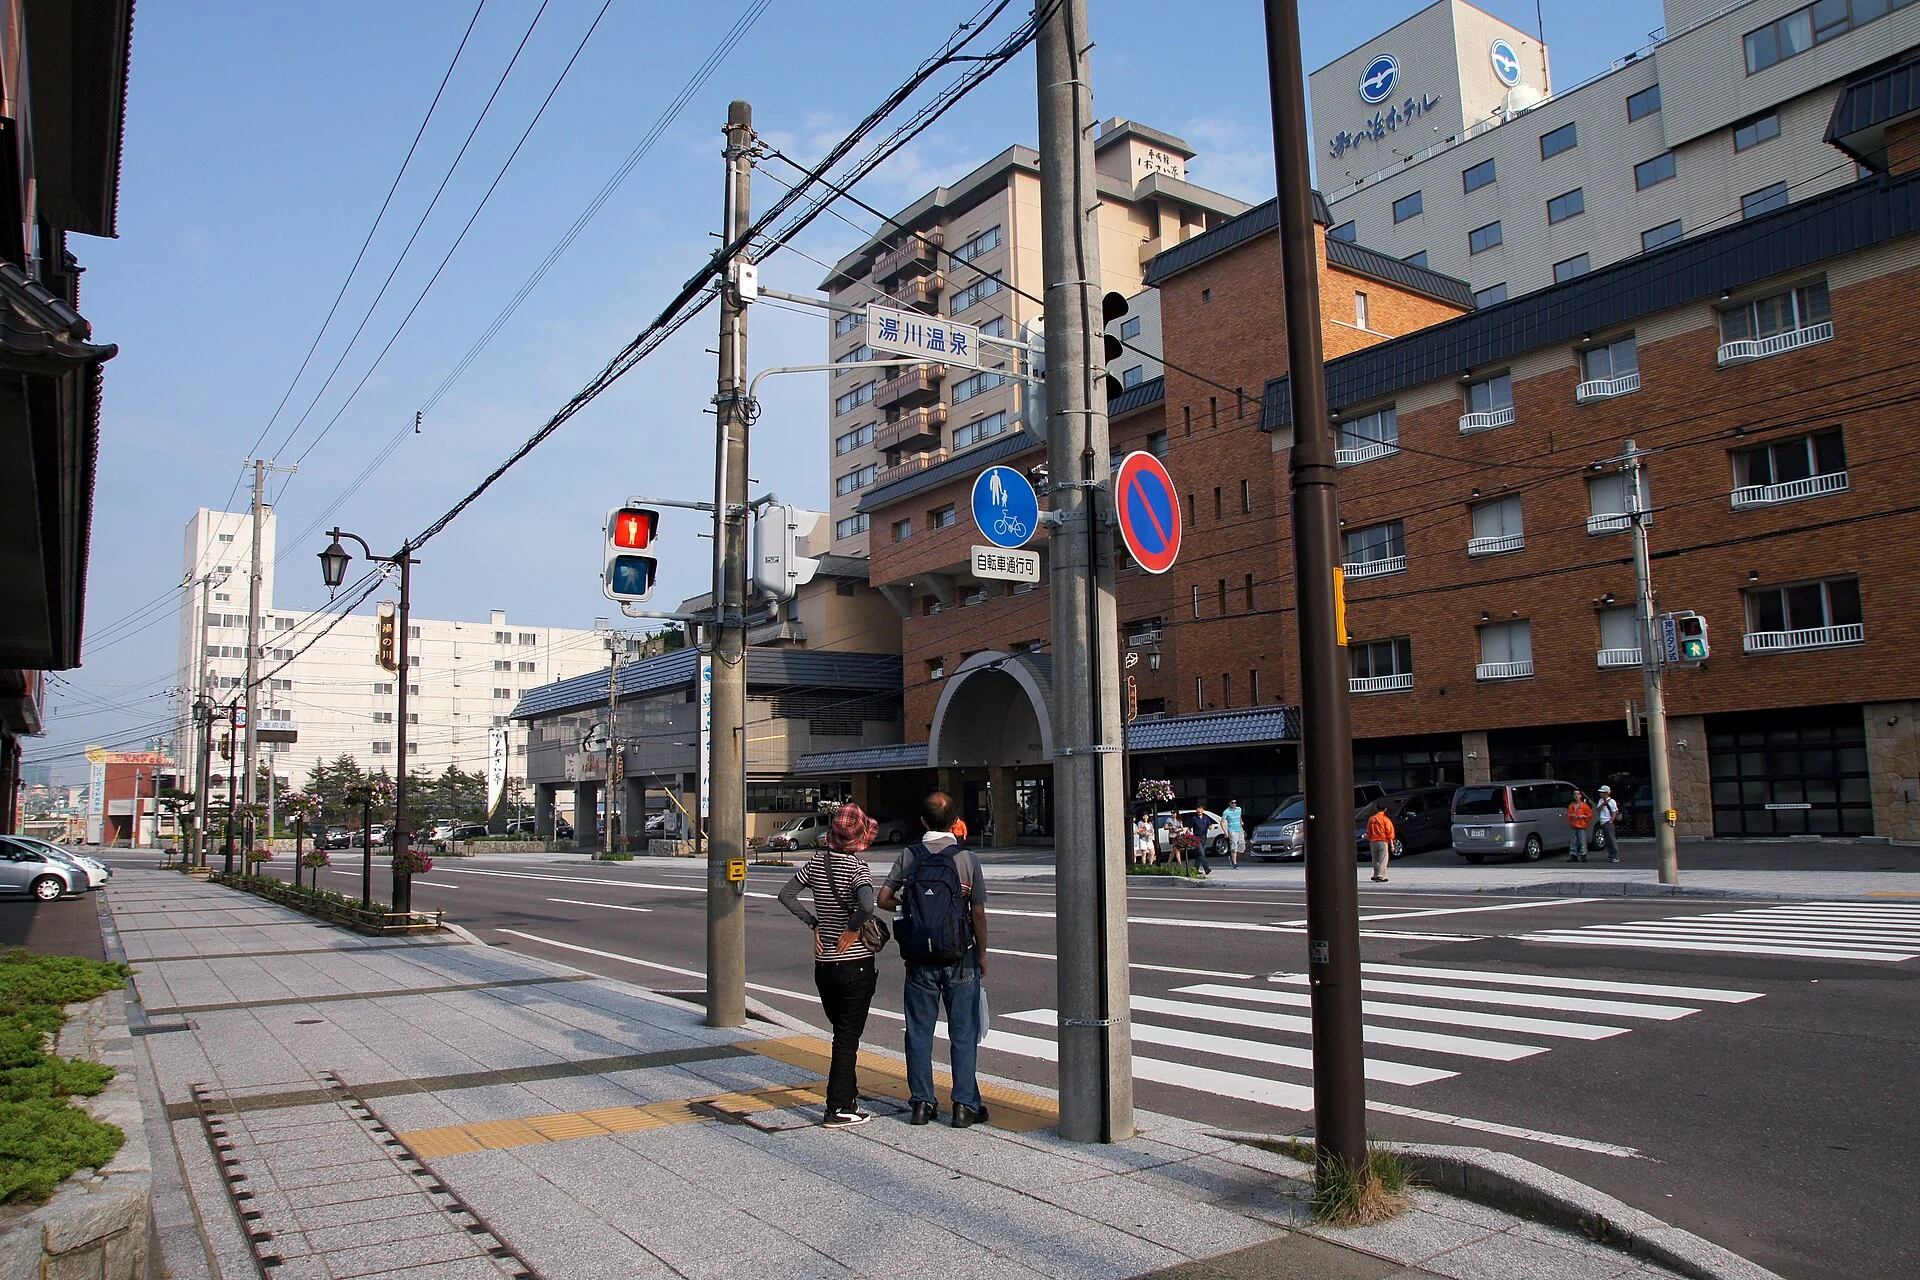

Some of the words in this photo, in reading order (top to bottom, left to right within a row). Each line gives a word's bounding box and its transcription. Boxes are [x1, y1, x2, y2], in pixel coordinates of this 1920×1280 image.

[878, 316, 968, 356] 湯川温泉
[977, 553, 1035, 576] 自転車通行可
[382, 623, 393, 660] 湯の川
[1665, 620, 1677, 661] 押ボタン式
